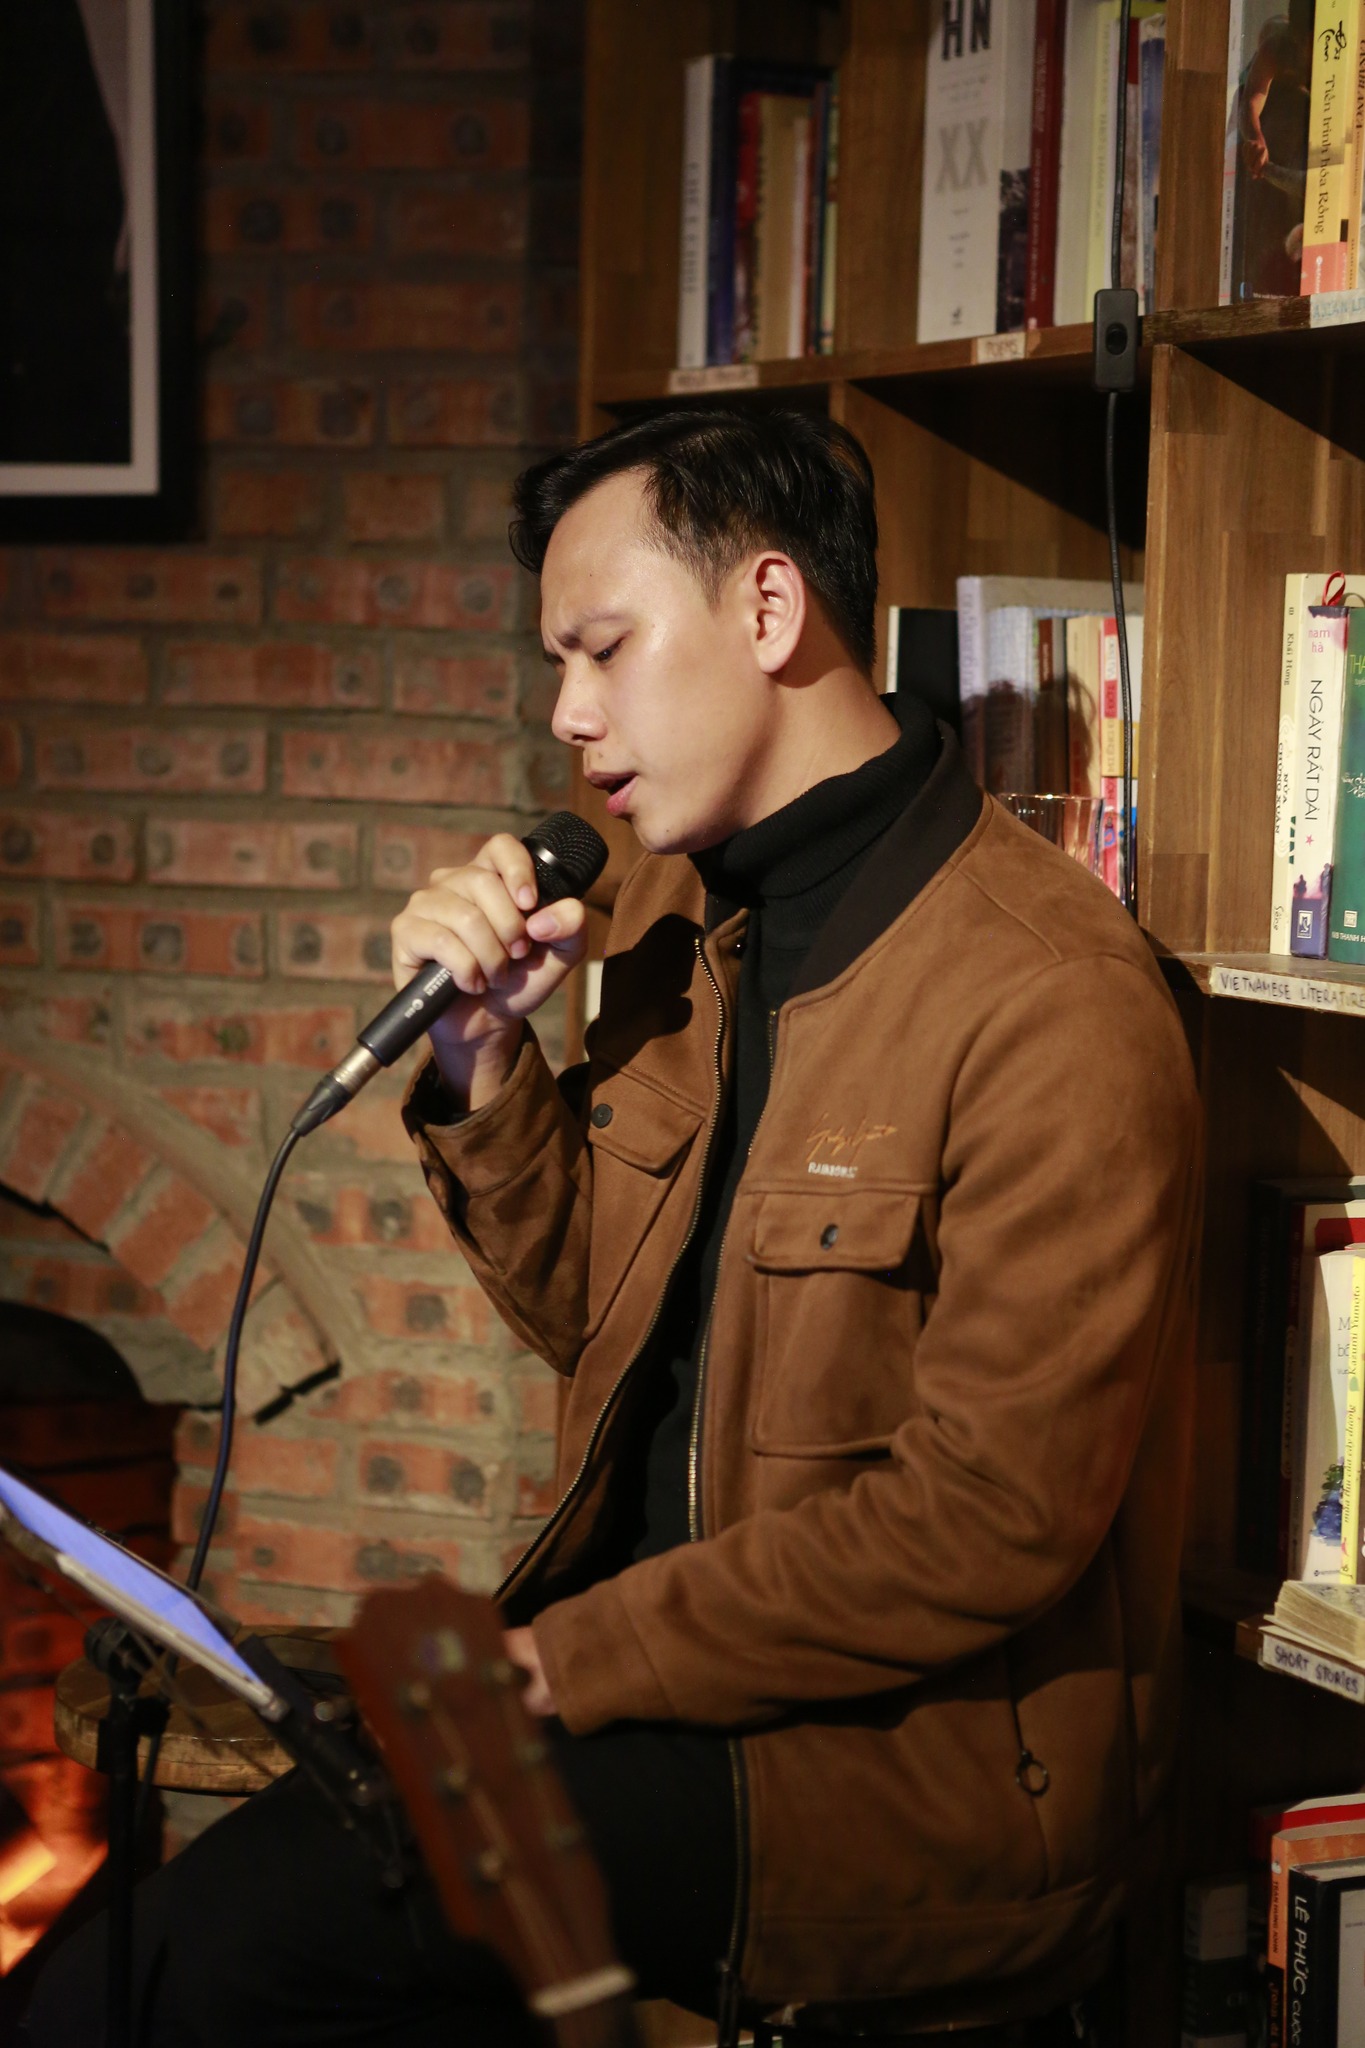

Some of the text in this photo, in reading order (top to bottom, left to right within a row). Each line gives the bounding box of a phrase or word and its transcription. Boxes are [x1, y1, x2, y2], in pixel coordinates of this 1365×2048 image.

[936, 119, 989, 194] XX
[1304, 679, 1325, 820] NGÀY RẤT DÀI
[1219, 971, 1292, 1000] VIETNAMESE
[1348, 1285, 1361, 1375] Kazumi Yumoto
[1274, 1645, 1359, 1695] SHORT STORIES
[1295, 1895, 1310, 1924] LÊ
